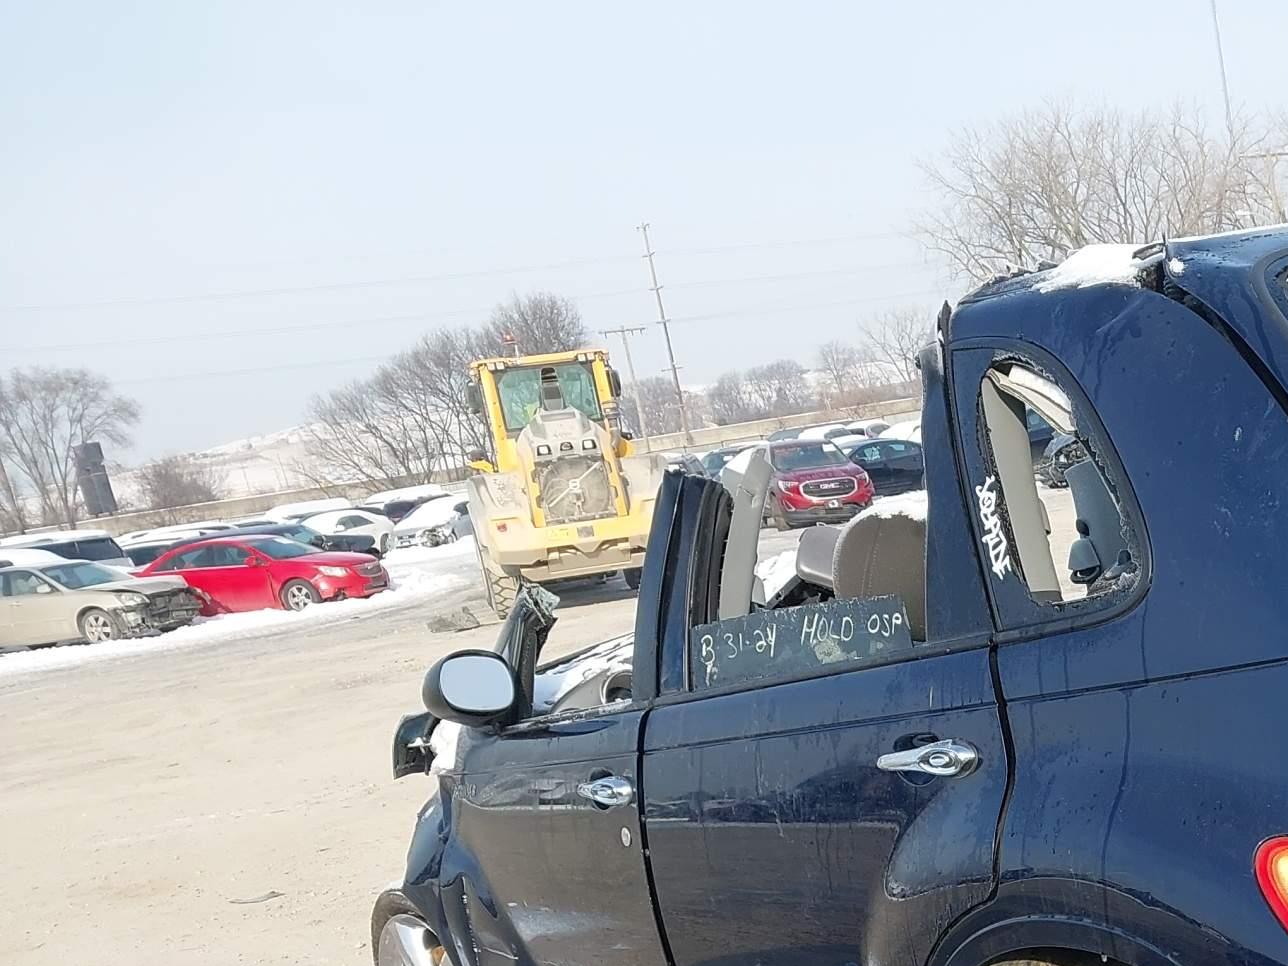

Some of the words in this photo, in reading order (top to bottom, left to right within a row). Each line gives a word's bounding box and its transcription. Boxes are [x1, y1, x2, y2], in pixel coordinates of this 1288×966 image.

[820, 482, 840, 490] GMC
[800, 612, 854, 645] HOLD
[867, 612, 902, 637] OSP
